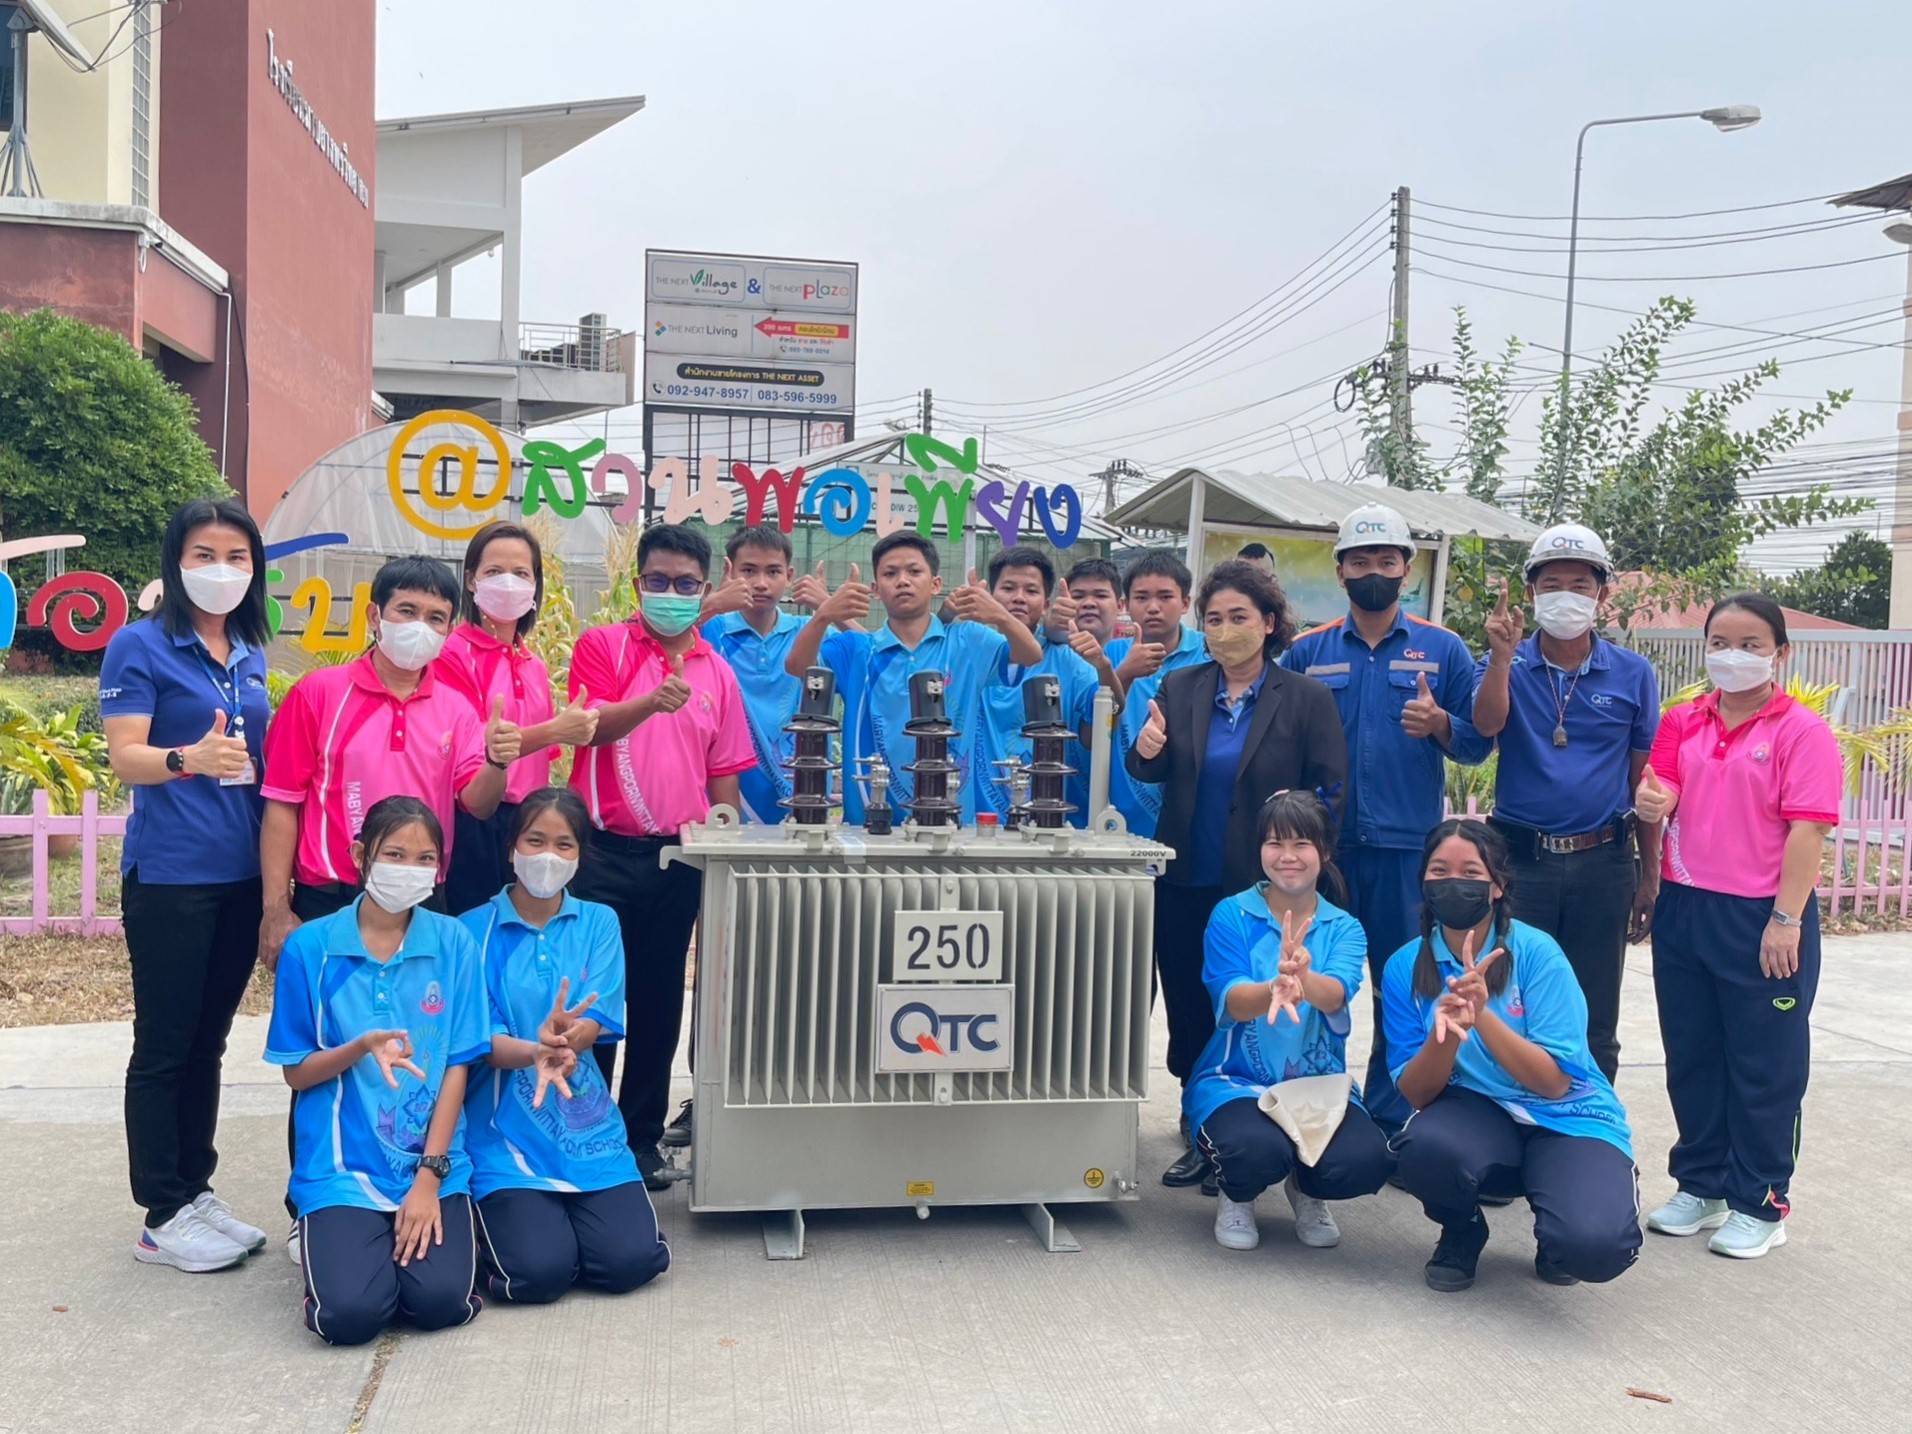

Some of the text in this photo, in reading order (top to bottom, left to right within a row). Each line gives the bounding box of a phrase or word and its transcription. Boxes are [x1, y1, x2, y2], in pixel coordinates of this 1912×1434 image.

[656, 276, 669, 285] THE
[670, 277, 689, 286] NEXT
[690, 268, 738, 296] Village
[747, 278, 761, 295] &
[769, 284, 783, 293] THE
[784, 285, 802, 294] NEXT
[668, 324, 738, 339] THE NEXT Living
[762, 372, 775, 380] THE
[777, 373, 796, 382] NEXT
[798, 374, 819, 383] ASSET
[667, 384, 837, 404] 092-947-8957 083-596-5999
[1355, 521, 1387, 534] QTC
[1552, 537, 1584, 550] QTC
[1403, 648, 1426, 659] QTC
[907, 923, 990, 970] 250
[890, 1002, 1000, 1057] QTC
